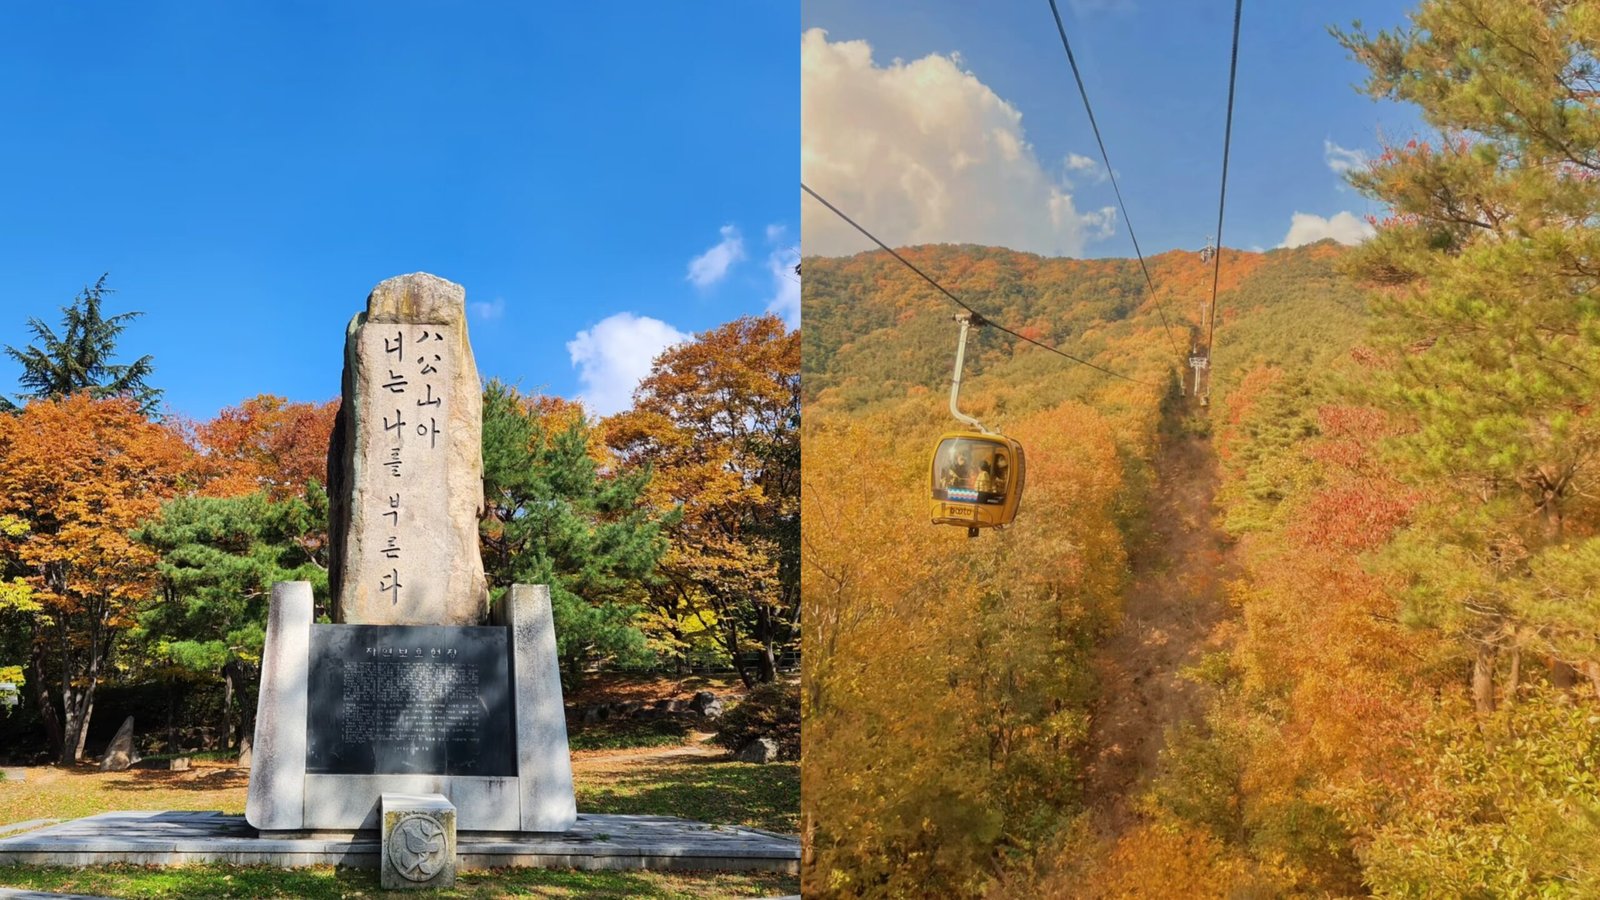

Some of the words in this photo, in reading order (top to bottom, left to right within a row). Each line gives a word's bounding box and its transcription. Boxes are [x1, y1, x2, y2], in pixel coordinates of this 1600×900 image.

[382, 331, 408, 393] 너는
[383, 409, 406, 477] 나를
[379, 493, 403, 606] 부른다
[366, 647, 457, 658] 자연보호헌장
